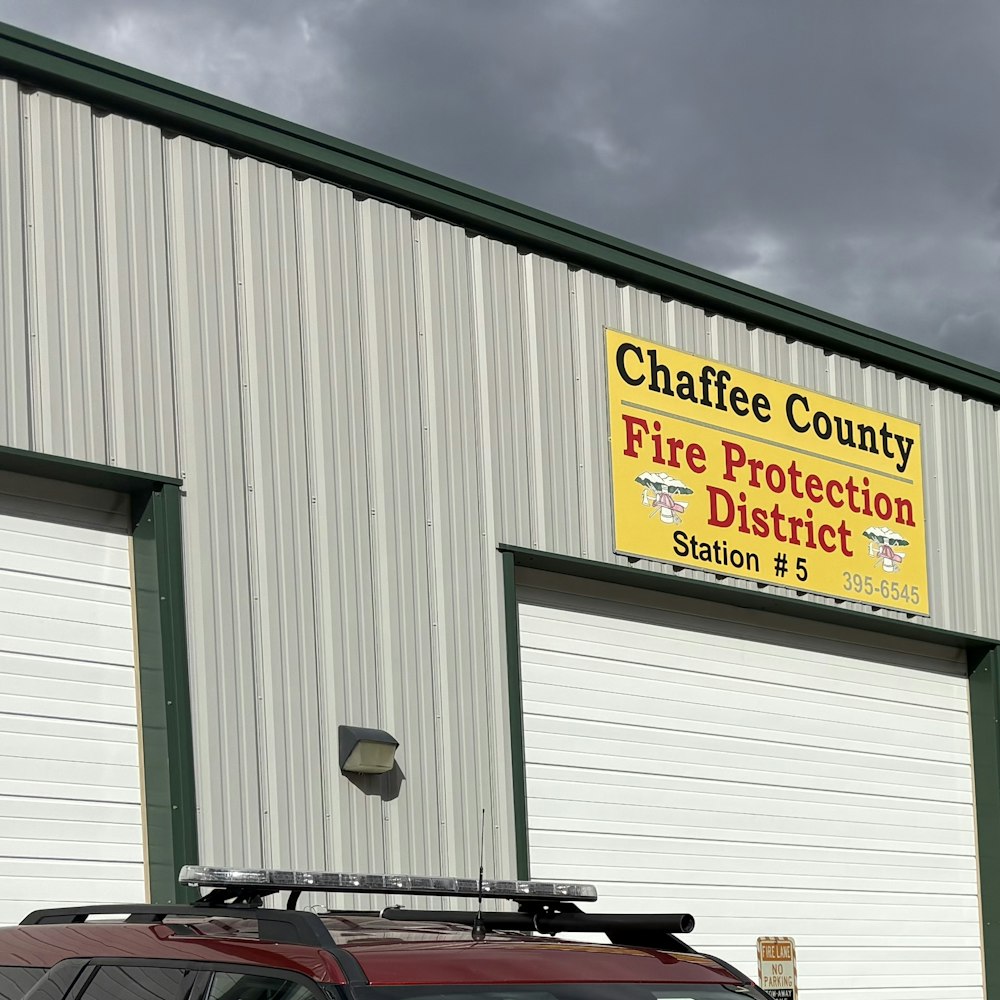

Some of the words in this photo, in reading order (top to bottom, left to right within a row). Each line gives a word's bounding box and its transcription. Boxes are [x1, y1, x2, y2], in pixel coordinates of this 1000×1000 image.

[615, 342, 771, 423] Chaffee
[785, 393, 914, 473] County
[621, 413, 707, 474] Fire
[721, 440, 916, 528] Protection
[706, 484, 853, 557] District
[673, 530, 760, 573] Station
[774, 553, 788, 578] #
[795, 557, 808, 582] 5
[842, 571, 921, 606] 395-6545
[762, 946, 775, 958] FIRE
[776, 946, 791, 958] LANE
[772, 964, 783, 975] NO
[764, 976, 792, 987] PARKING
